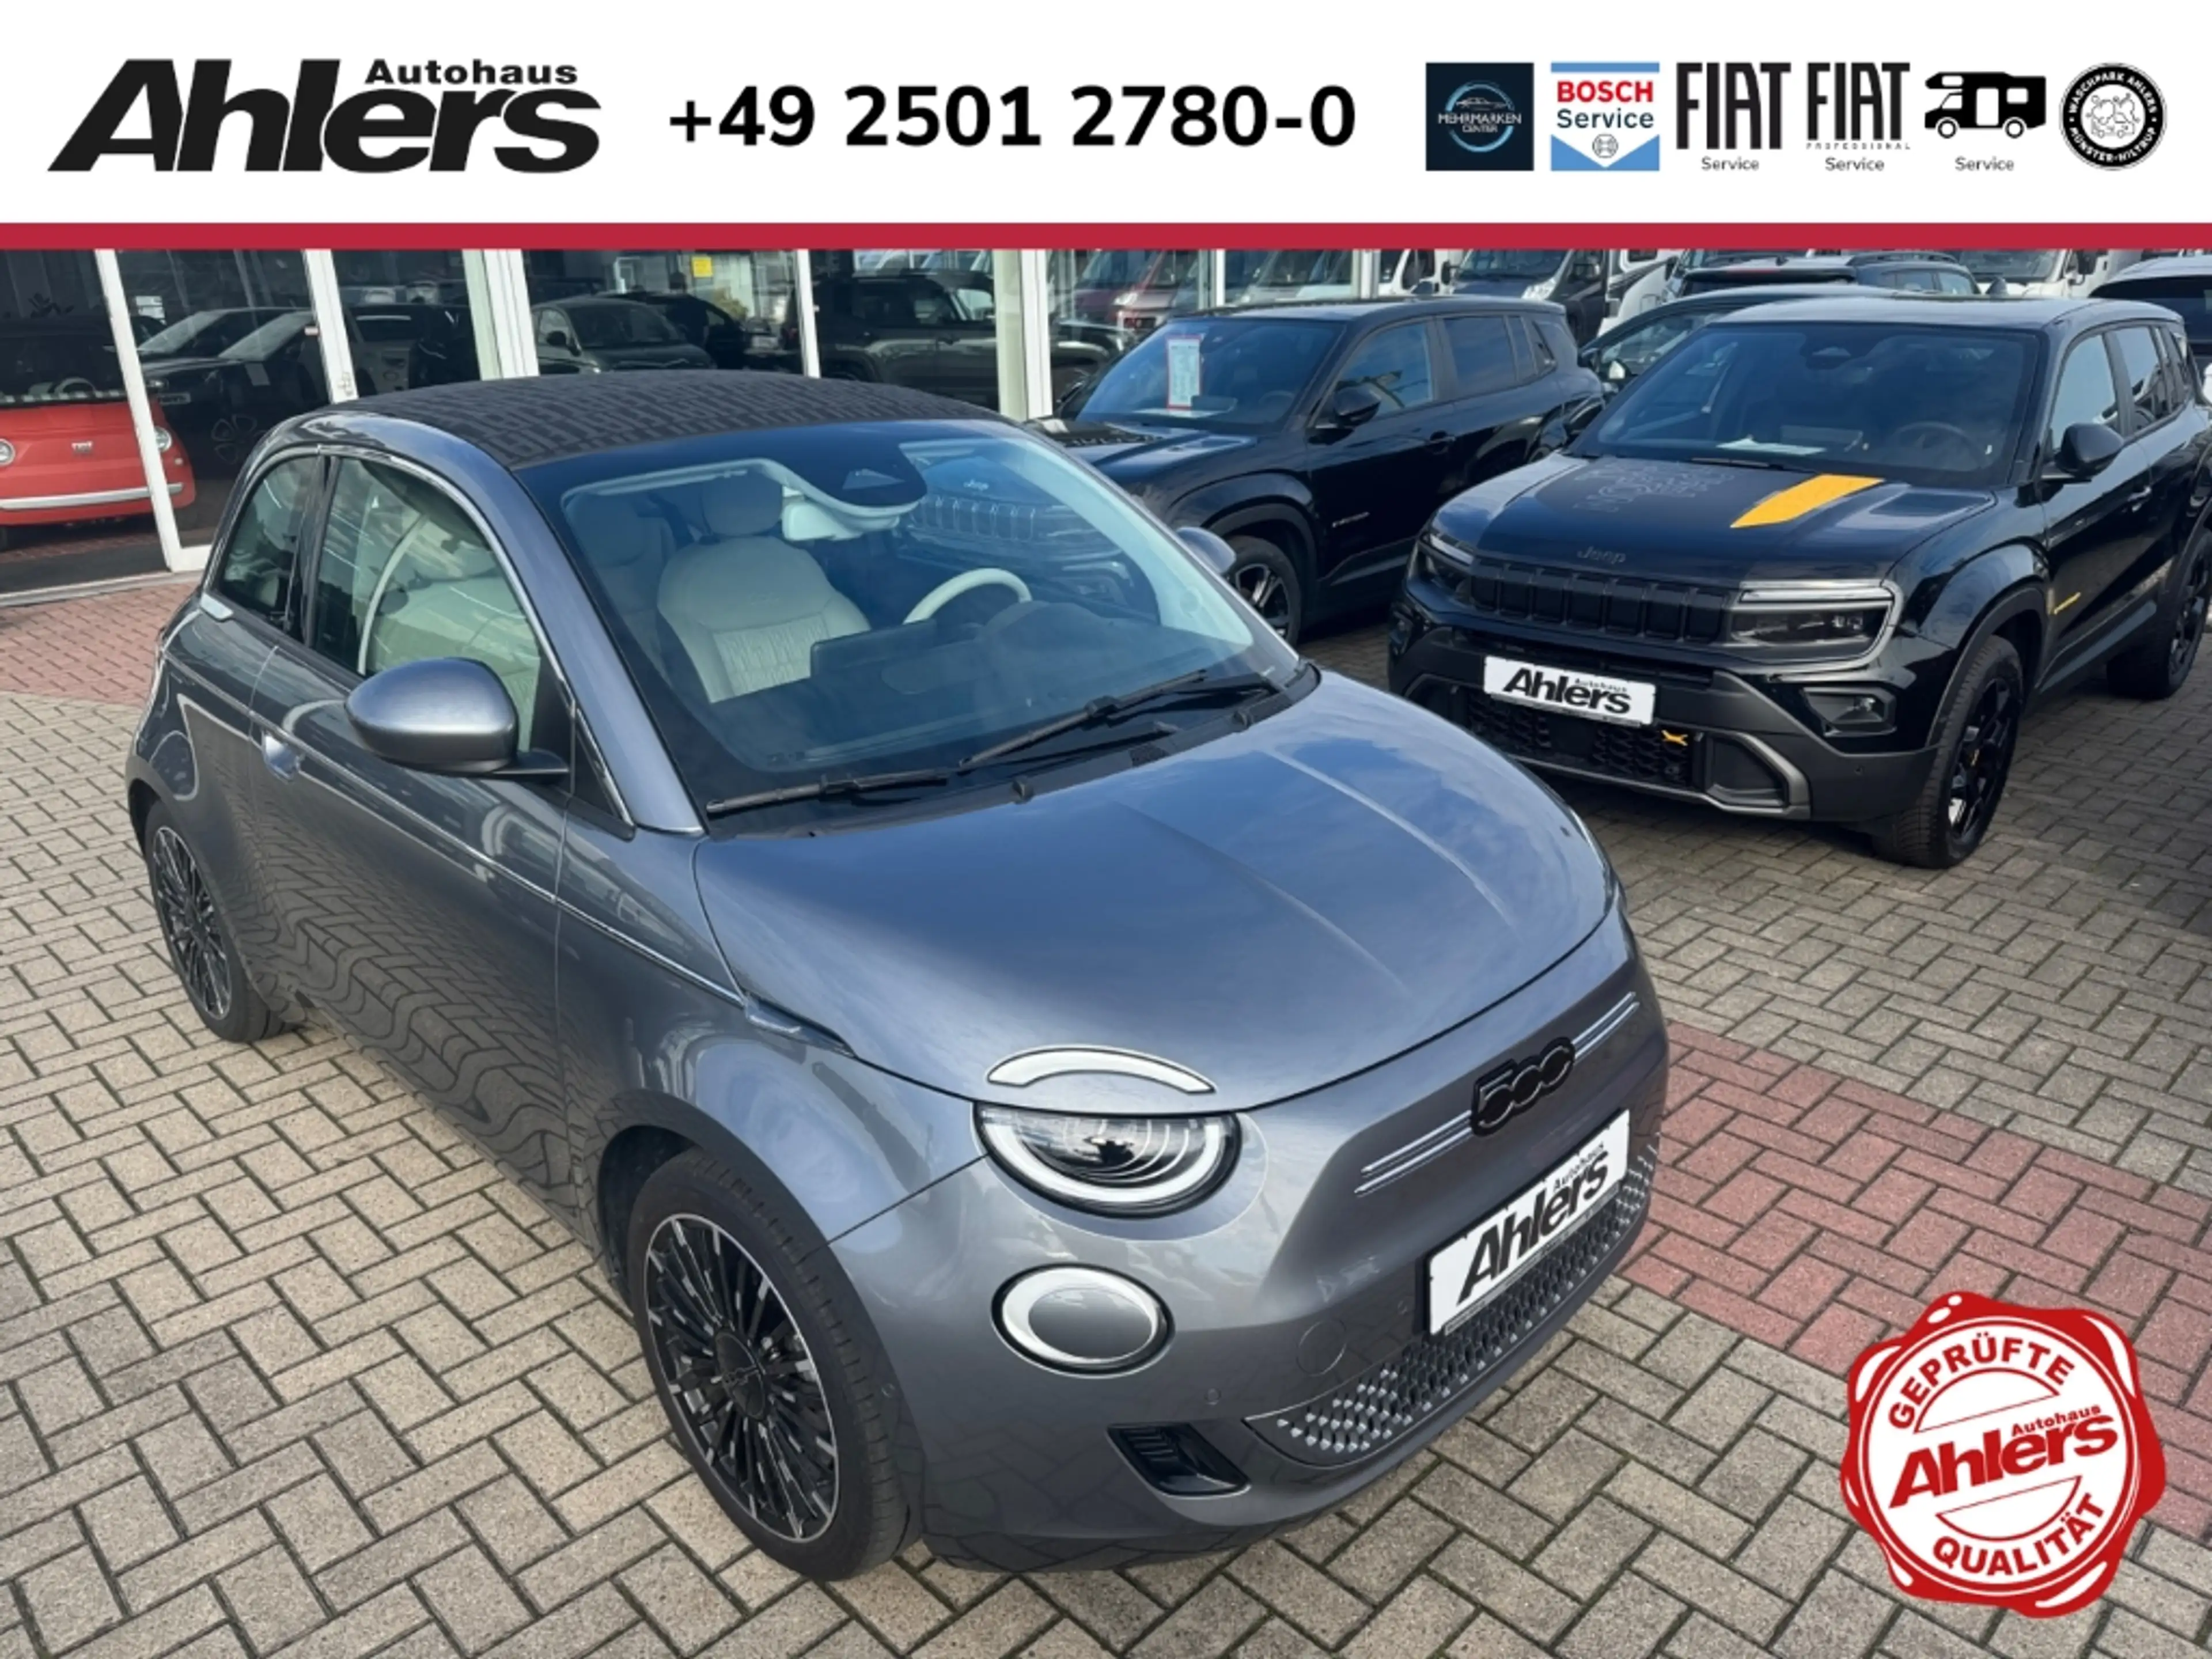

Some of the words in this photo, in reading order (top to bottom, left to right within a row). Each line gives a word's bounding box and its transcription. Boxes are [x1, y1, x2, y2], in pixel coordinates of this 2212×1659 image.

[1502, 667, 1632, 714] Ahlers
[1471, 1036, 1576, 1138] 500
[1456, 1150, 1609, 1306] Ahlers
